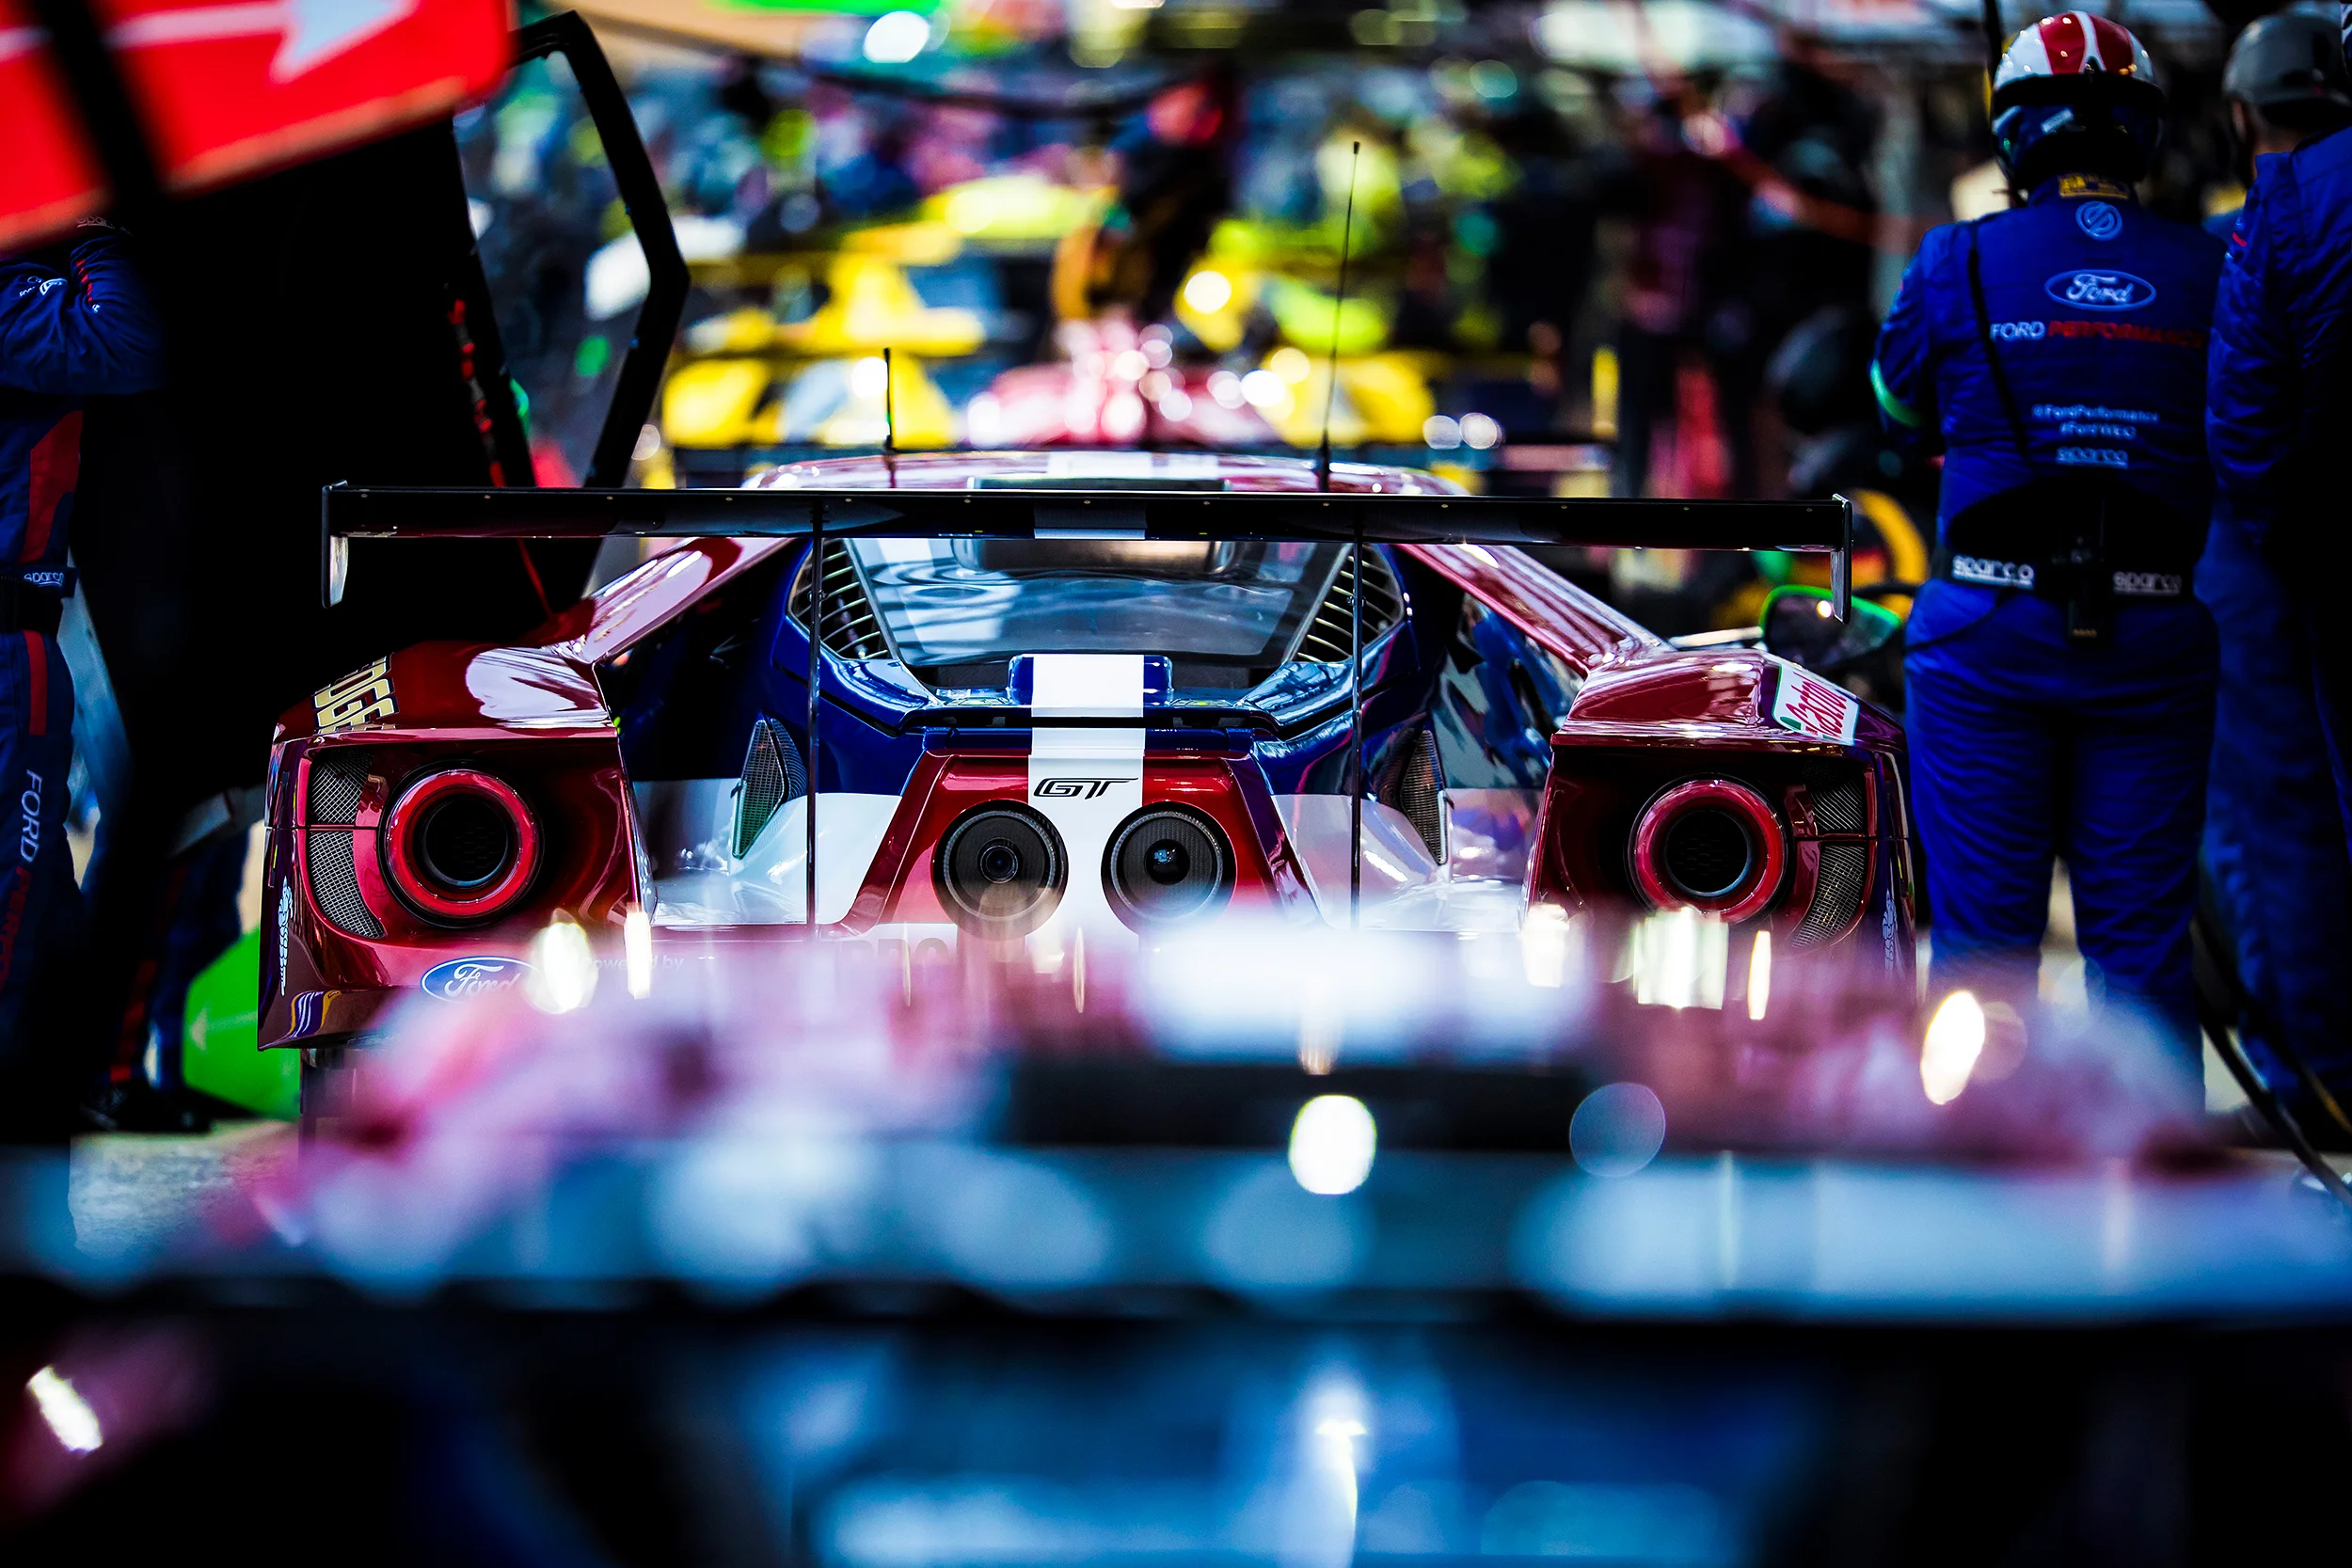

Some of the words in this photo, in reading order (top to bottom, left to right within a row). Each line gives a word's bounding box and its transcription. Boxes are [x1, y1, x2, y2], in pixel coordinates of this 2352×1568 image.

[2065, 274, 2134, 303] Ford
[1990, 322, 2045, 341] FORD
[1952, 556, 2034, 589] sparco
[1034, 777, 1139, 800] GT
[21, 769, 42, 863] FORD
[444, 963, 521, 998] Ford
